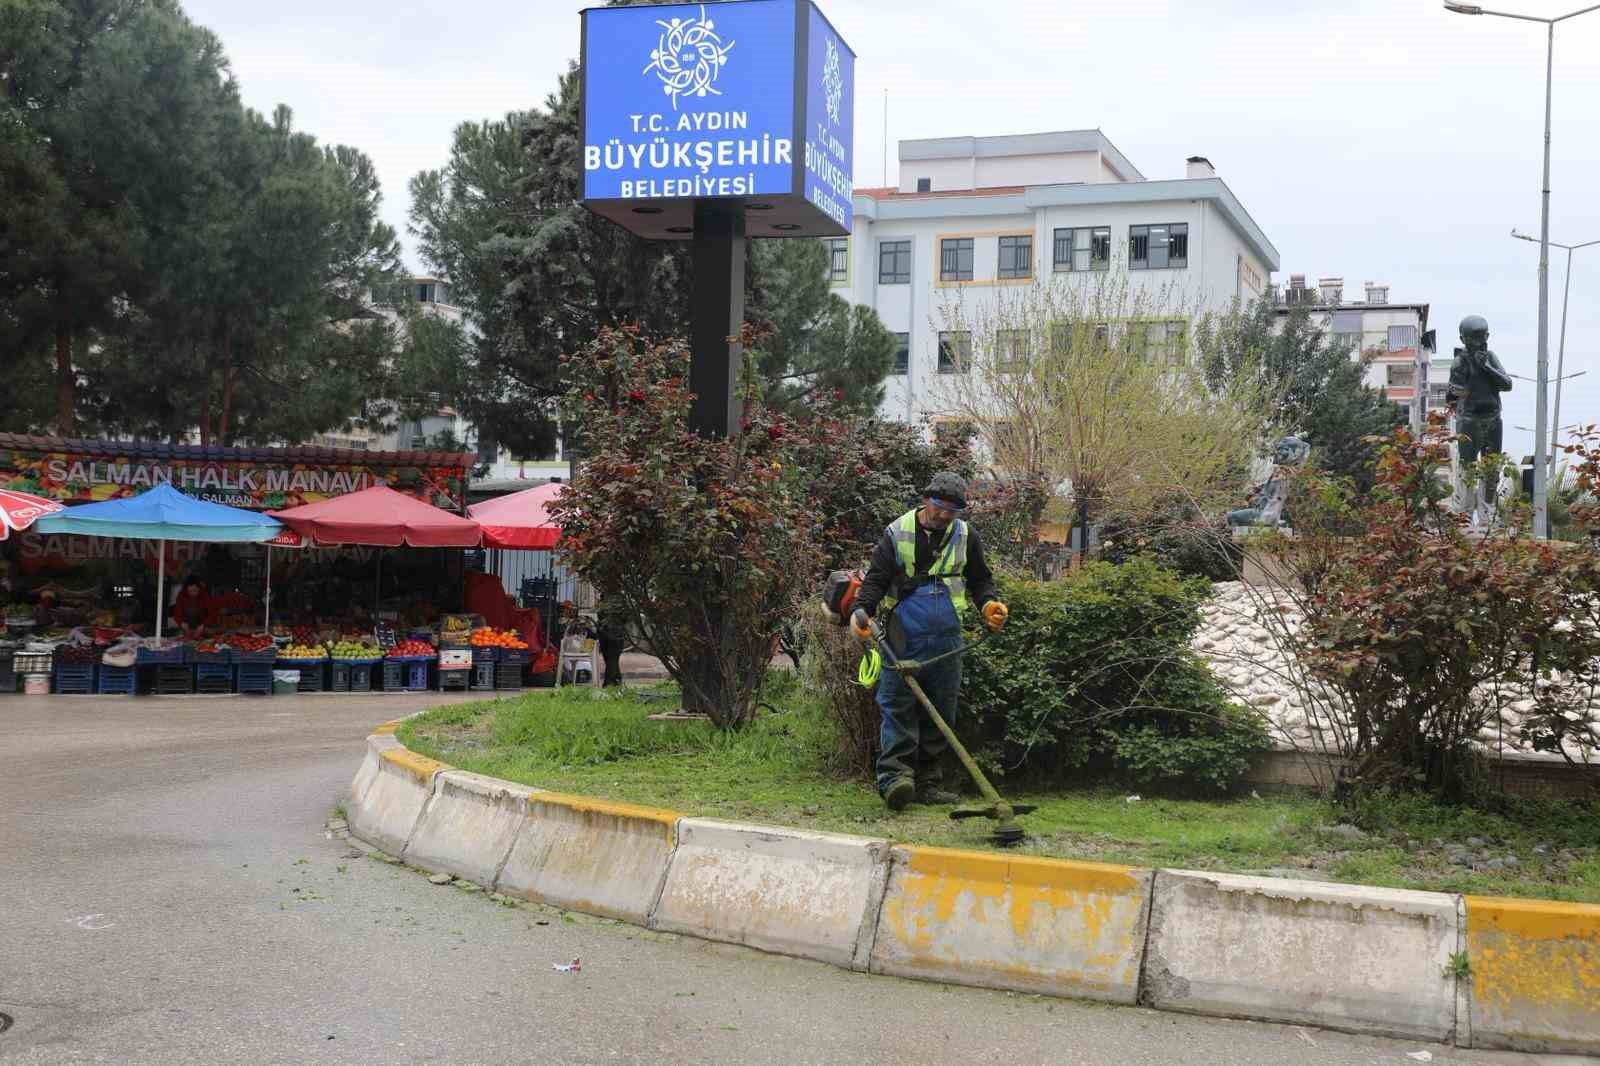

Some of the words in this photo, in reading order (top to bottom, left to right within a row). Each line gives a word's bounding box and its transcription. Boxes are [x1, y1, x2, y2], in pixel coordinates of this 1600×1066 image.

[630, 114, 669, 133] T.C.
[676, 111, 747, 131] AYDIN
[584, 133, 792, 174] BÜYÜKŞEHİR
[829, 135, 845, 163] AYDIN
[620, 173, 754, 199] BELEDİYESİ
[813, 185, 845, 225] BELEDİYESİ
[48, 460, 172, 487] SALMAN
[181, 466, 257, 490] HALK
[266, 469, 368, 493] MANAVI
[202, 493, 253, 505] SALMAN
